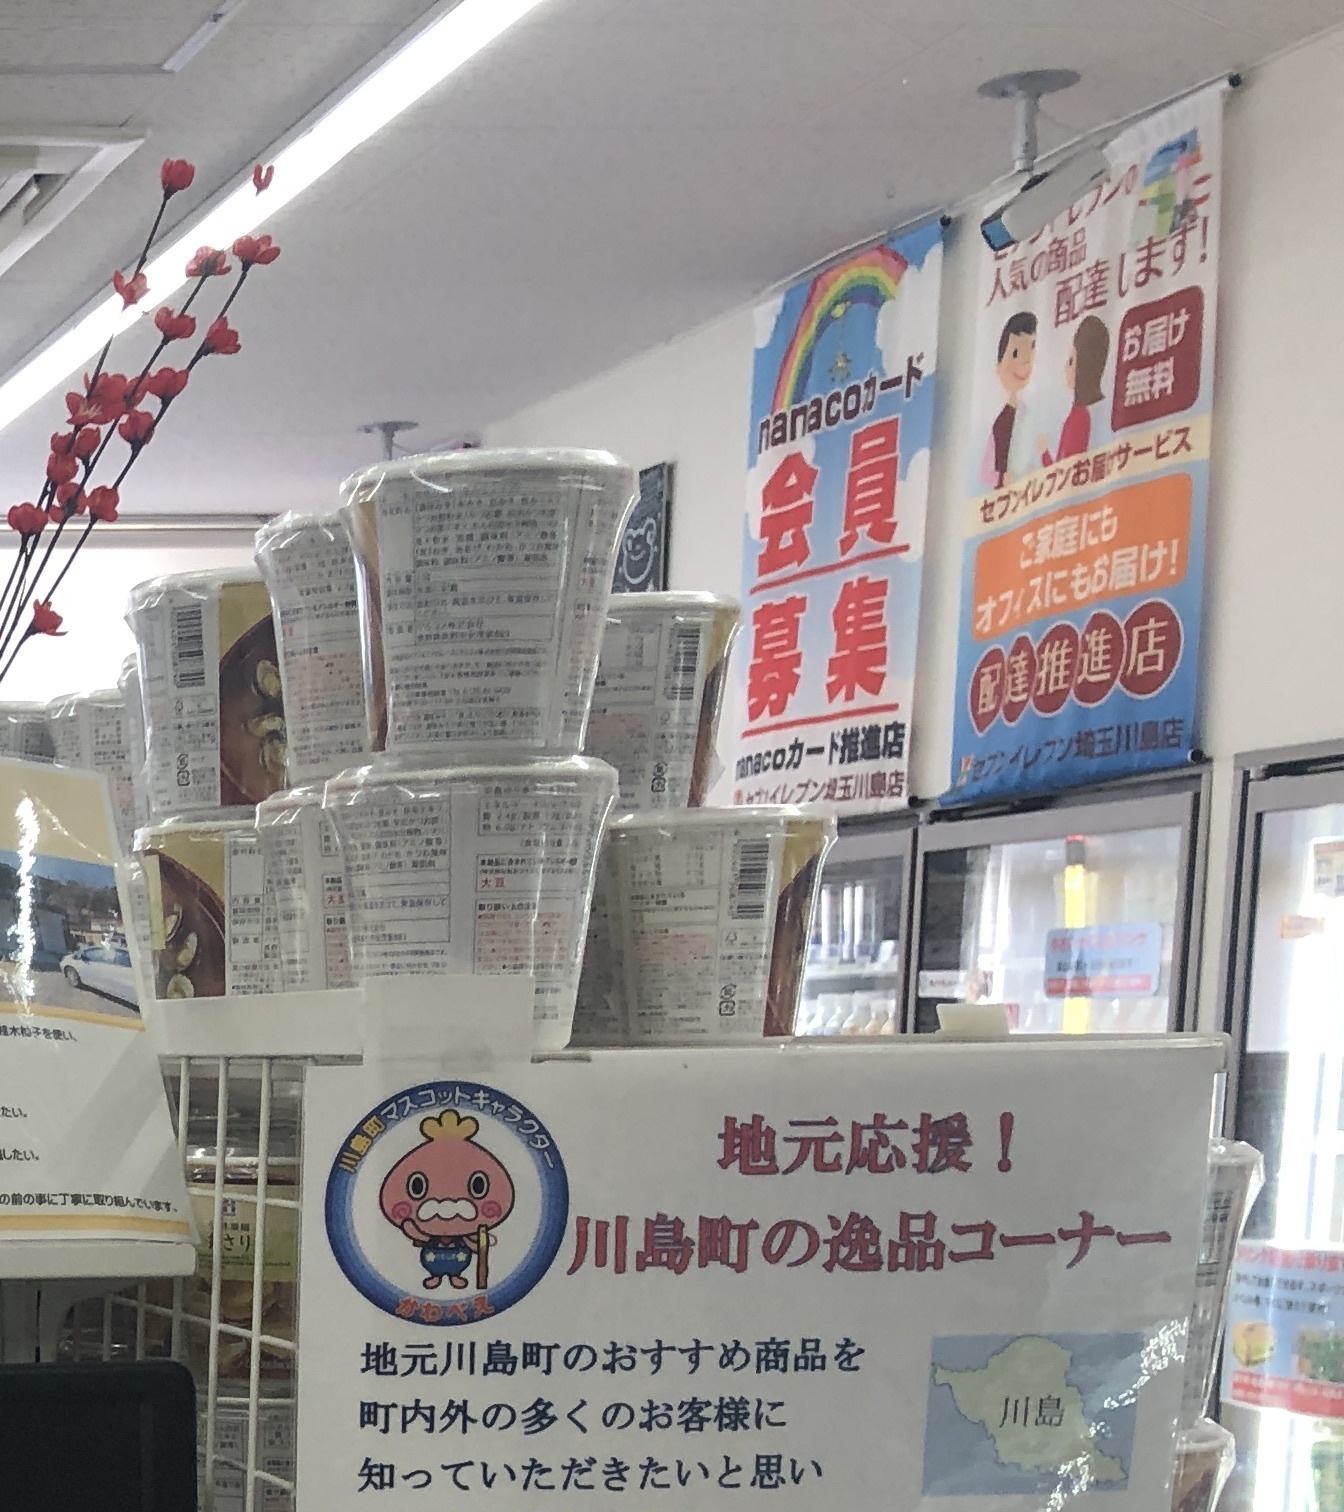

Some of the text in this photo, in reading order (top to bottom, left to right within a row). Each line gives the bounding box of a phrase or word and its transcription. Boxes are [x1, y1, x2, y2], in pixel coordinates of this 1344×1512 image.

[986, 226, 1087, 308] 人気の商品
[1054, 216, 1209, 328] 配達します！
[1122, 308, 1191, 361] お届け
[759, 354, 924, 454] nanacoカード
[1124, 356, 1175, 408] 無料
[758, 417, 900, 577] 会員
[1020, 505, 1117, 569] ご家庭にも
[976, 539, 1179, 633] オフィスにもお届け！
[748, 575, 890, 723] 募集
[977, 618, 1170, 715] 配達推進店
[736, 722, 905, 781] nanacoカード推進店
[339, 1085, 554, 1174] 川島町 マスコットキャラクター
[717, 1110, 1016, 1177] 地元応援！
[565, 1212, 1172, 1277] 川島町の逸品コーナー
[395, 1295, 495, 1322] かわべえ
[360, 1339, 866, 1376] 地元川島町のおすすめ商品を
[359, 1398, 788, 1435] 町内外の多くのお客様に
[999, 1395, 1064, 1430] 川島
[357, 1455, 824, 1493] 知っていただきたいと思い
